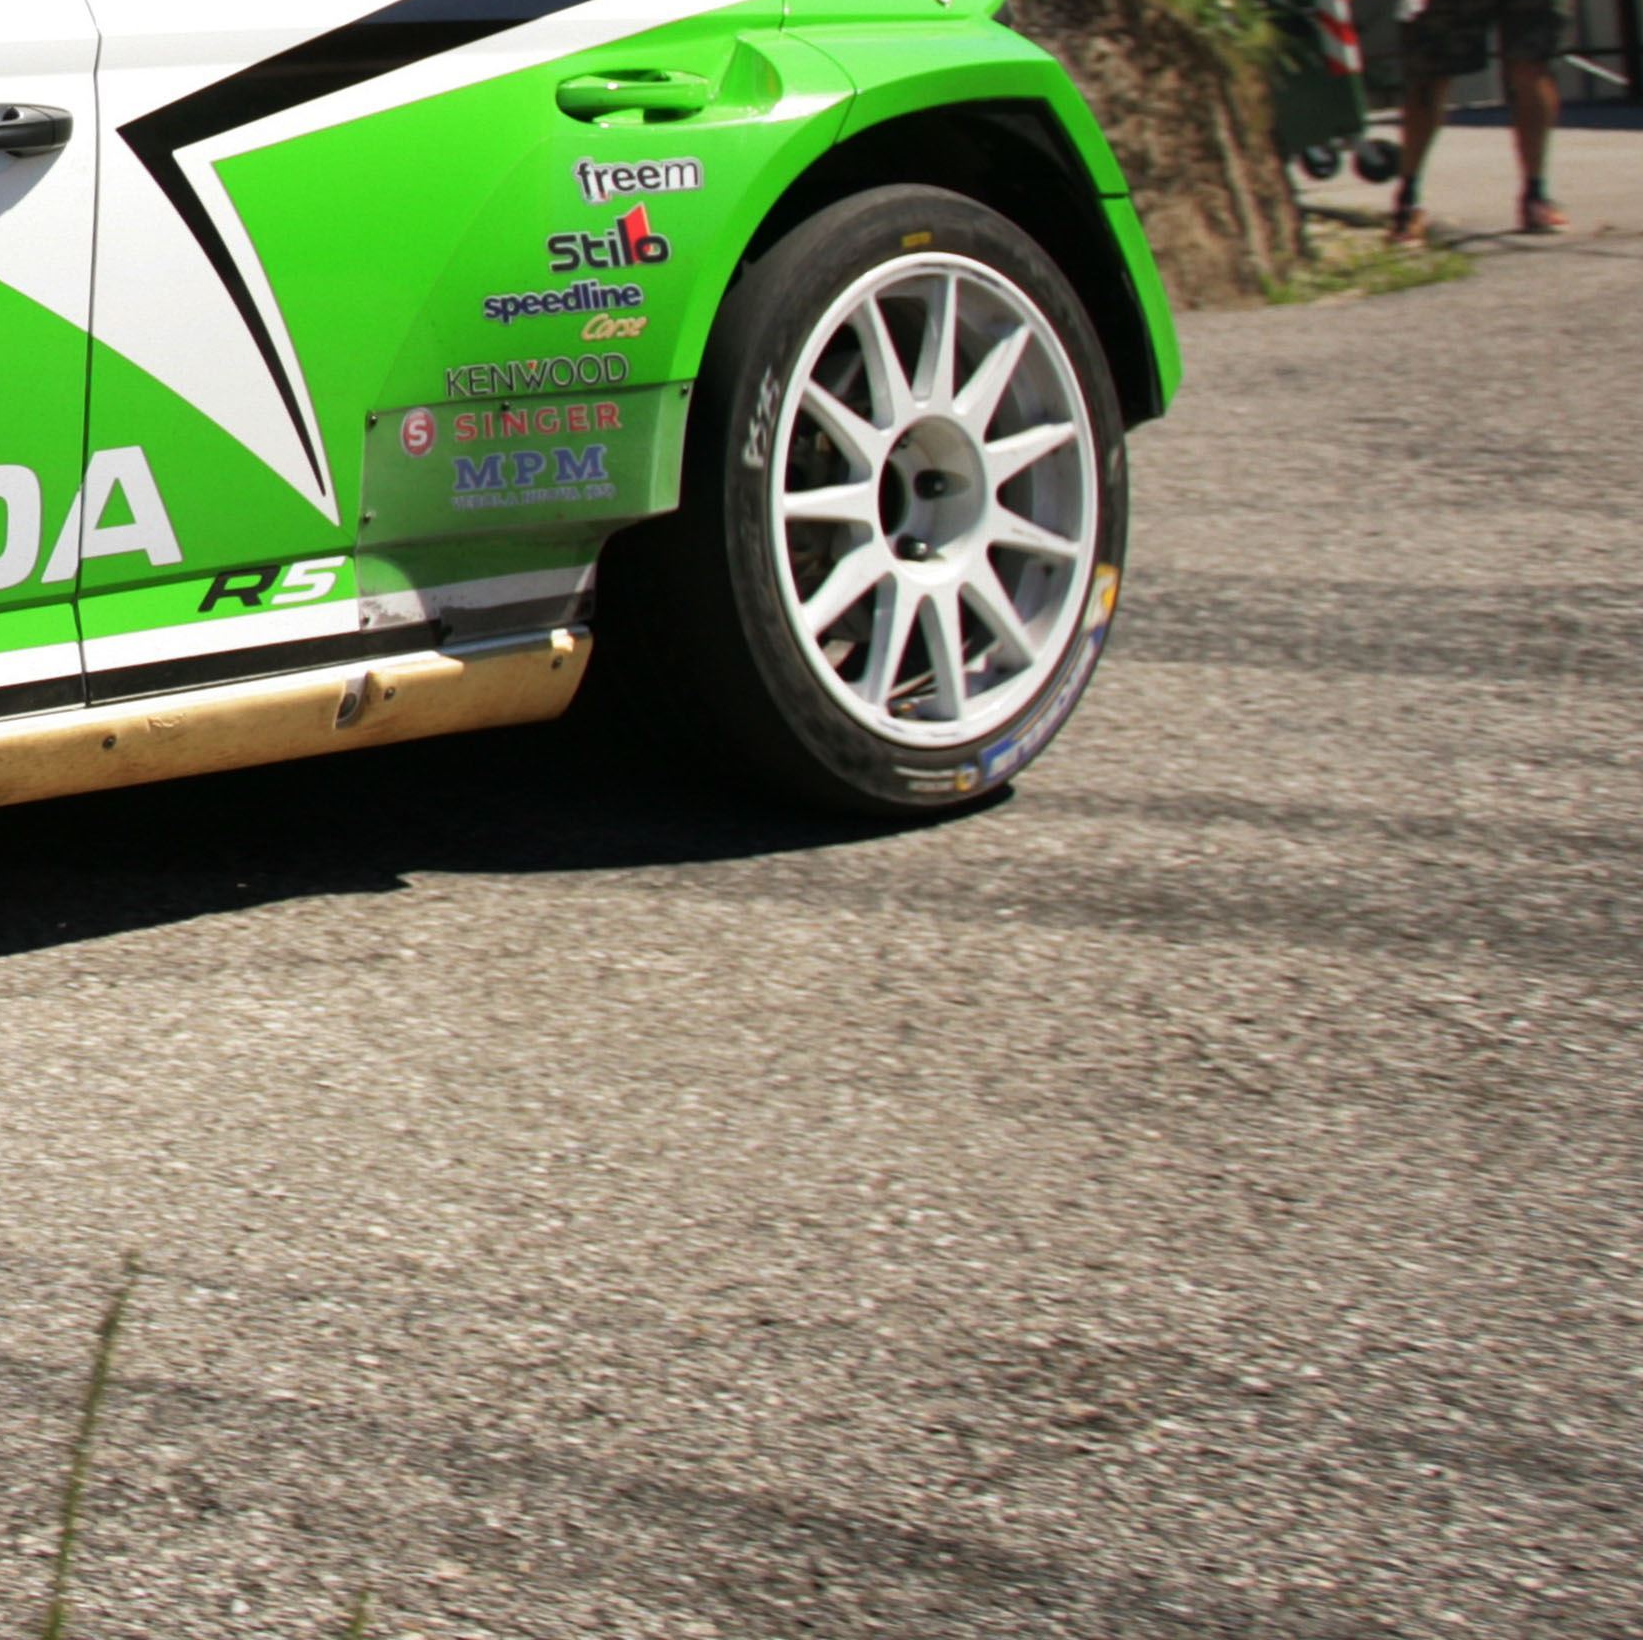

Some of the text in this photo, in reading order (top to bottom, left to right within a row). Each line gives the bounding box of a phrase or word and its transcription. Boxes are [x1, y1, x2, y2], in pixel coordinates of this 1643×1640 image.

[577, 161, 699, 200] freem
[547, 205, 670, 272] Stilo
[484, 281, 642, 325] speedline
[446, 352, 629, 398] KENWOOD
[454, 401, 623, 442] SINGER
[198, 555, 349, 612] R5
